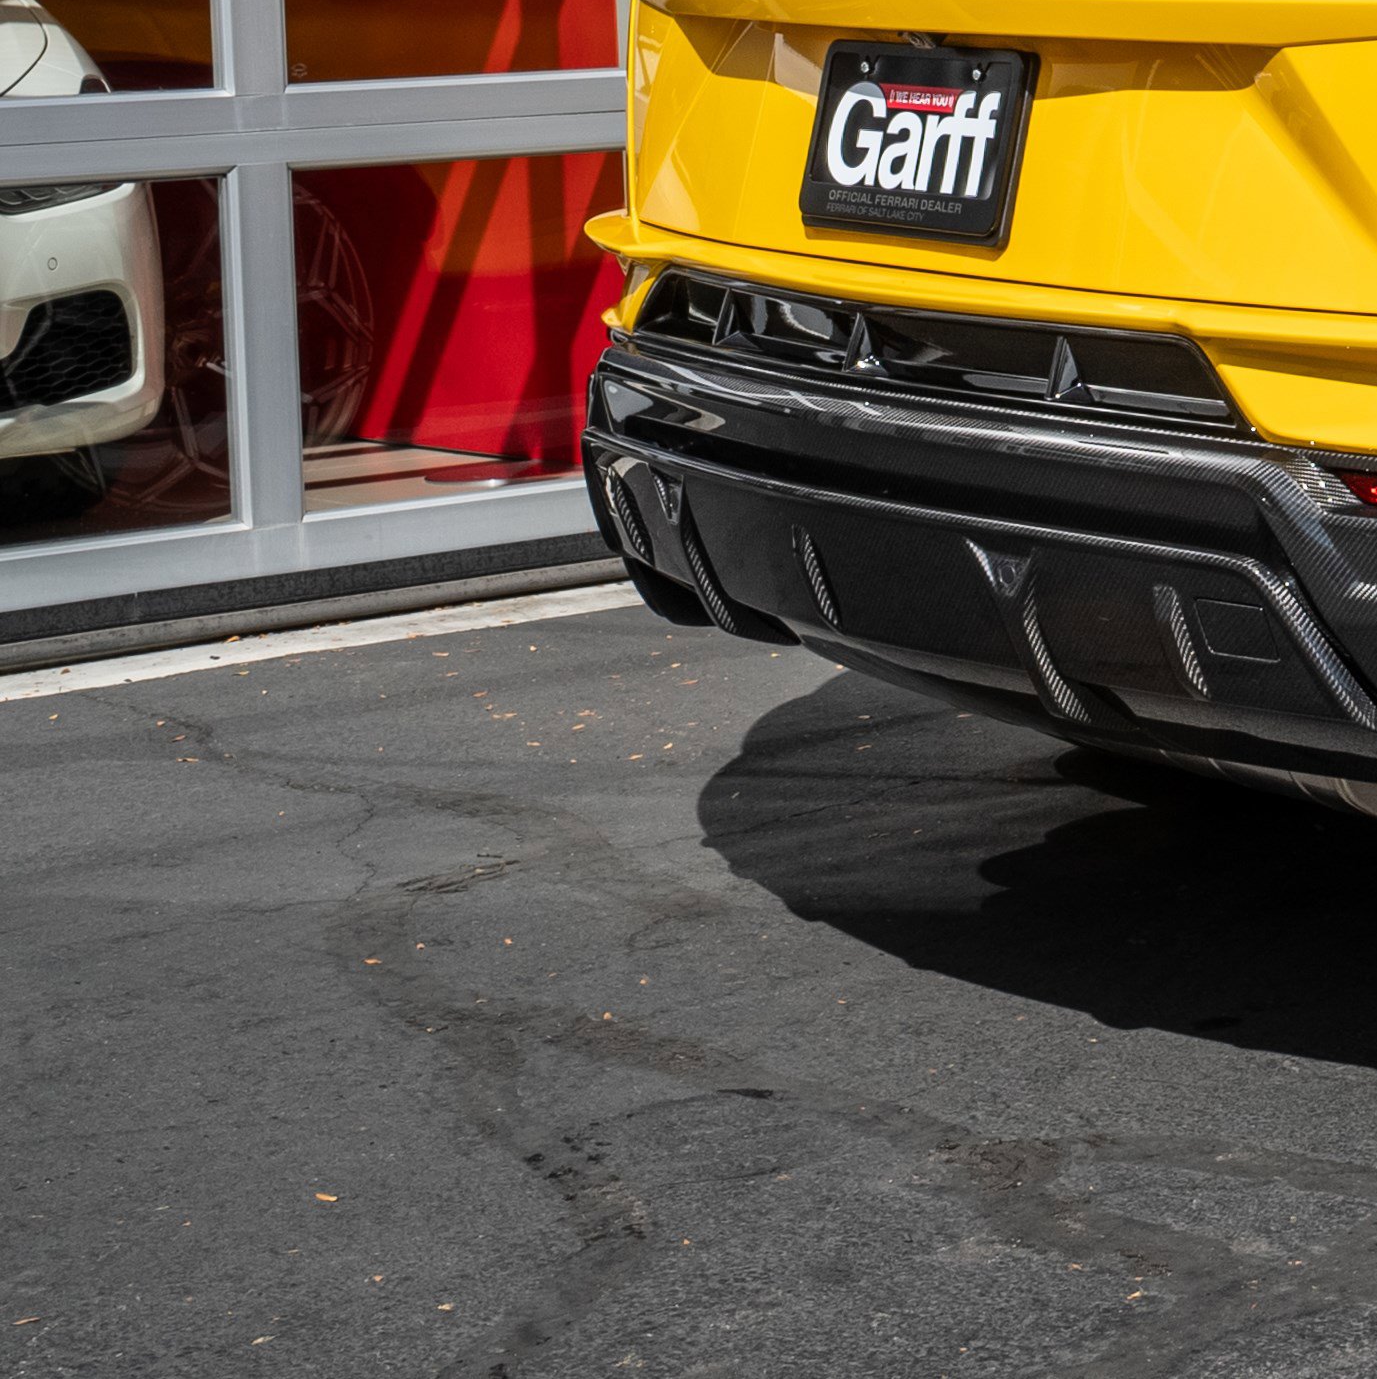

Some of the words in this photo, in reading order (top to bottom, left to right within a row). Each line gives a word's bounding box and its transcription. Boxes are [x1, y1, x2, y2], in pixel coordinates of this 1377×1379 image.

[909, 92, 931, 106] HEAR
[932, 93, 949, 107] YOU
[827, 81, 1001, 198] Garff
[826, 203, 856, 214] FERRARI
[857, 206, 869, 216] OF
[869, 207, 886, 218] SALT
[887, 209, 906, 220] LAKE
[907, 211, 925, 222] CITY
[828, 189, 873, 205] OFFICIAL
[874, 194, 919, 210] FERRARI
[920, 199, 963, 215] DEALER
